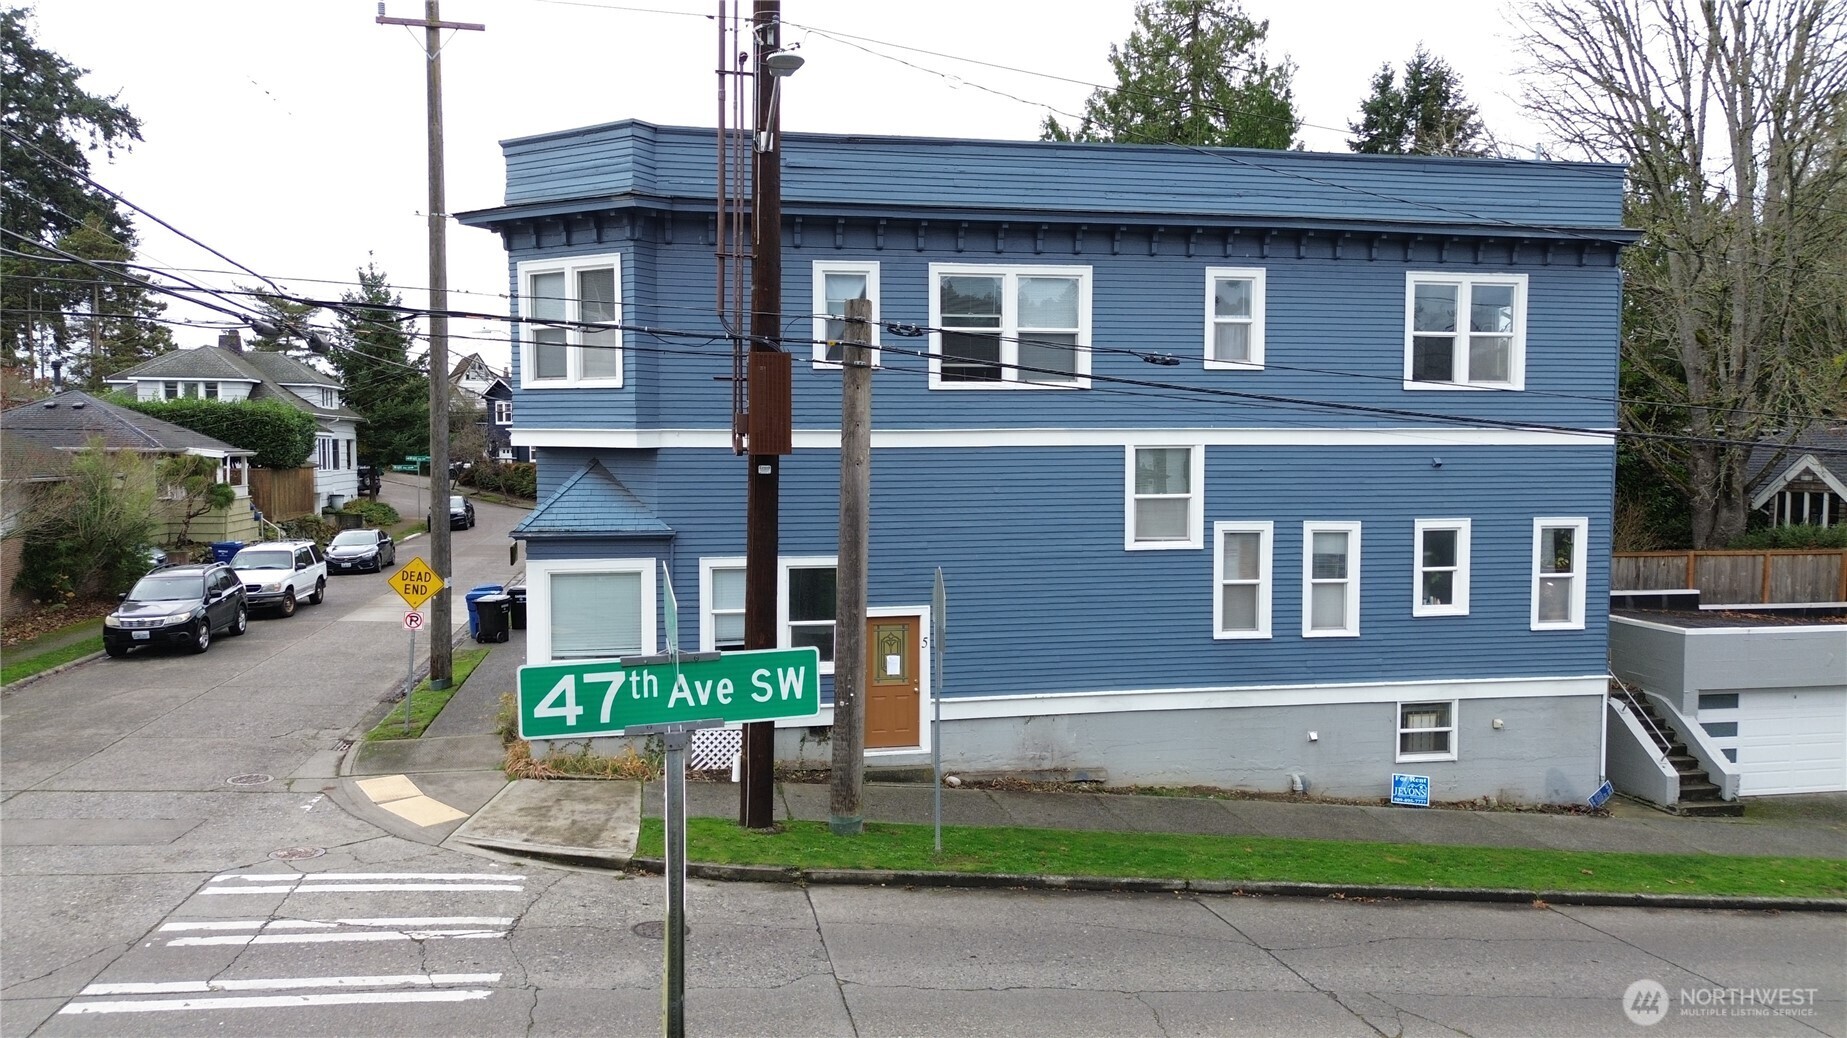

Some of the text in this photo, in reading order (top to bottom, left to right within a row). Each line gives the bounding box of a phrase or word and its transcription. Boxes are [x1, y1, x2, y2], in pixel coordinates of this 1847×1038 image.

[402, 570, 431, 582] DEAD
[404, 584, 427, 595] END
[921, 636, 929, 649] 5
[533, 665, 806, 727] 47th Ave SW
